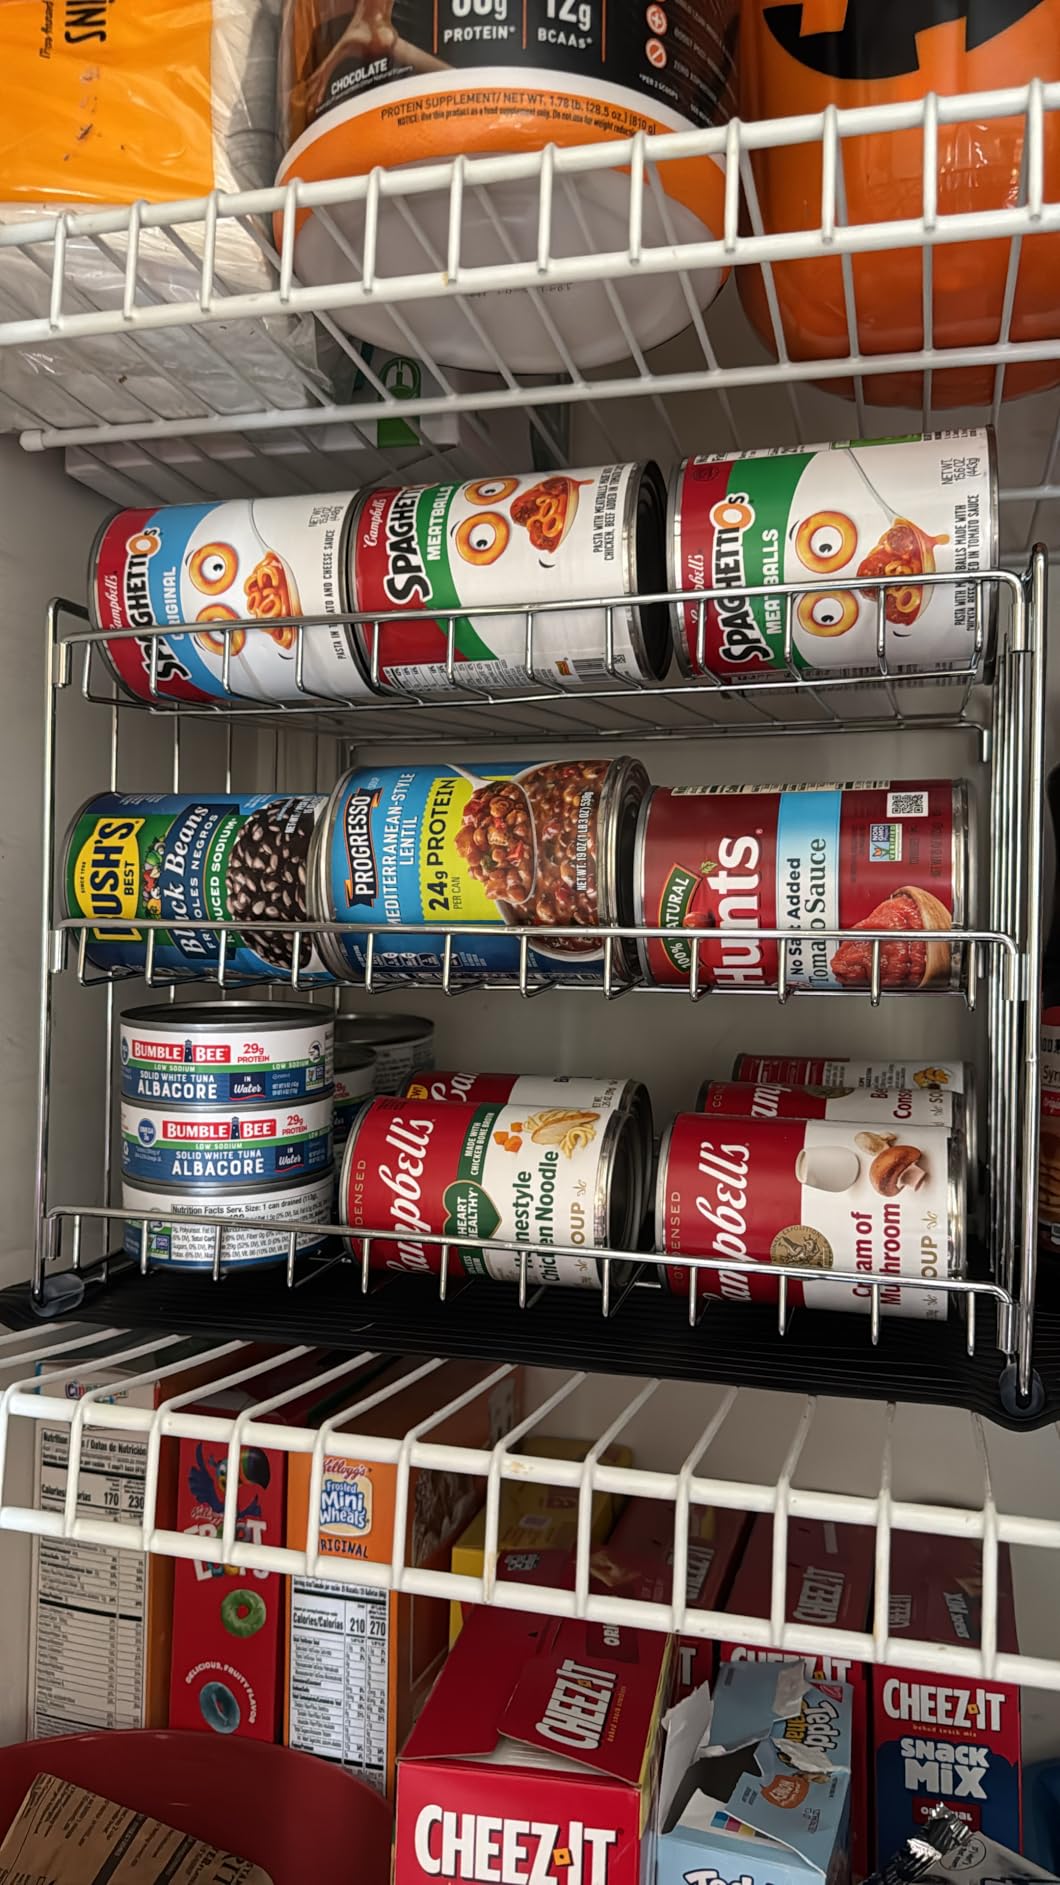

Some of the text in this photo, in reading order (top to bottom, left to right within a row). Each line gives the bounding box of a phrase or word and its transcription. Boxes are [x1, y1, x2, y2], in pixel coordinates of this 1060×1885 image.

[331, 57, 389, 96] CHOCOLATE
[380, 103, 424, 120] PROTEIN
[503, 92, 525, 103] NET
[527, 94, 546, 105] WT.
[549, 95, 570, 108] 1.78
[941, 468, 954, 485] NET
[967, 493, 980, 518] SAUCE
[604, 512, 616, 528] BEEF
[593, 532, 604, 553] PASTA
[968, 519, 980, 550] TOMATO
[954, 503, 967, 627] PASTA WITH MADE WITH
[968, 551, 980, 561] IN
[323, 529, 346, 660] PASTA IN AND CHEESE SAUCE
[164, 805, 209, 877] Beans
[190, 813, 219, 871] NEGROS
[211, 817, 237, 873] SODIUM
[349, 795, 375, 896] PROGRESSO
[400, 815, 418, 866] LENTIL
[427, 778, 459, 911] 24g PROTEIN
[576, 841, 587, 852] OZ
[576, 852, 587, 861] 19
[123, 860, 136, 896] BEST
[576, 879, 587, 891] NET
[451, 876, 463, 910] PER CAN
[786, 857, 804, 977] No Added
[804, 837, 830, 985] Tomao Sauce
[665, 878, 691, 970] 100% ATURAL
[134, 1041, 225, 1062] BUMBLE BEE
[237, 1054, 270, 1063] PROTEIN
[243, 1043, 264, 1055] 29g
[140, 1070, 215, 1083] SOLID WHITE TUNA
[153, 1063, 168, 1071] LOW
[137, 1078, 218, 1099] ALBACORE
[233, 1083, 263, 1094] Water
[243, 1075, 252, 1083] IN
[167, 1121, 273, 1138] BUMBLE BEE
[281, 1125, 308, 1136] PROTEIN
[286, 1114, 304, 1127] 29g
[175, 1149, 262, 1160] SOLID WHITE TUNA
[214, 1142, 243, 1150] SODIUM
[470, 1147, 484, 1176] CHICKEN
[477, 1130, 489, 1149] BONE
[171, 1158, 265, 1177] ALBACORE
[278, 1154, 302, 1166] Water
[535, 1150, 559, 1222] Noodle
[172, 1206, 203, 1214] Nutrition
[204, 1206, 225, 1214] Facts
[226, 1205, 244, 1214] Serv.
[244, 1203, 262, 1211] Size:
[267, 1203, 280, 1211] can
[457, 1196, 468, 1238] HEART
[570, 1202, 586, 1245] OUP
[851, 1211, 873, 1235] of
[879, 1203, 902, 1306] Muhroom
[920, 1235, 938, 1279] OUP
[325, 1481, 358, 1494] Frosted
[104, 1492, 120, 1506] 170
[128, 1494, 145, 1510] 230
[320, 1491, 364, 1511] Mini
[319, 1505, 366, 1529] Wheats
[320, 1538, 369, 1559] RIGINAL
[350, 1617, 365, 1634] 210
[369, 1620, 386, 1637] 270
[185, 1661, 257, 1724] DELICIOUS, FRUITY FLAVOR
[803, 1700, 841, 1752] Tedd
